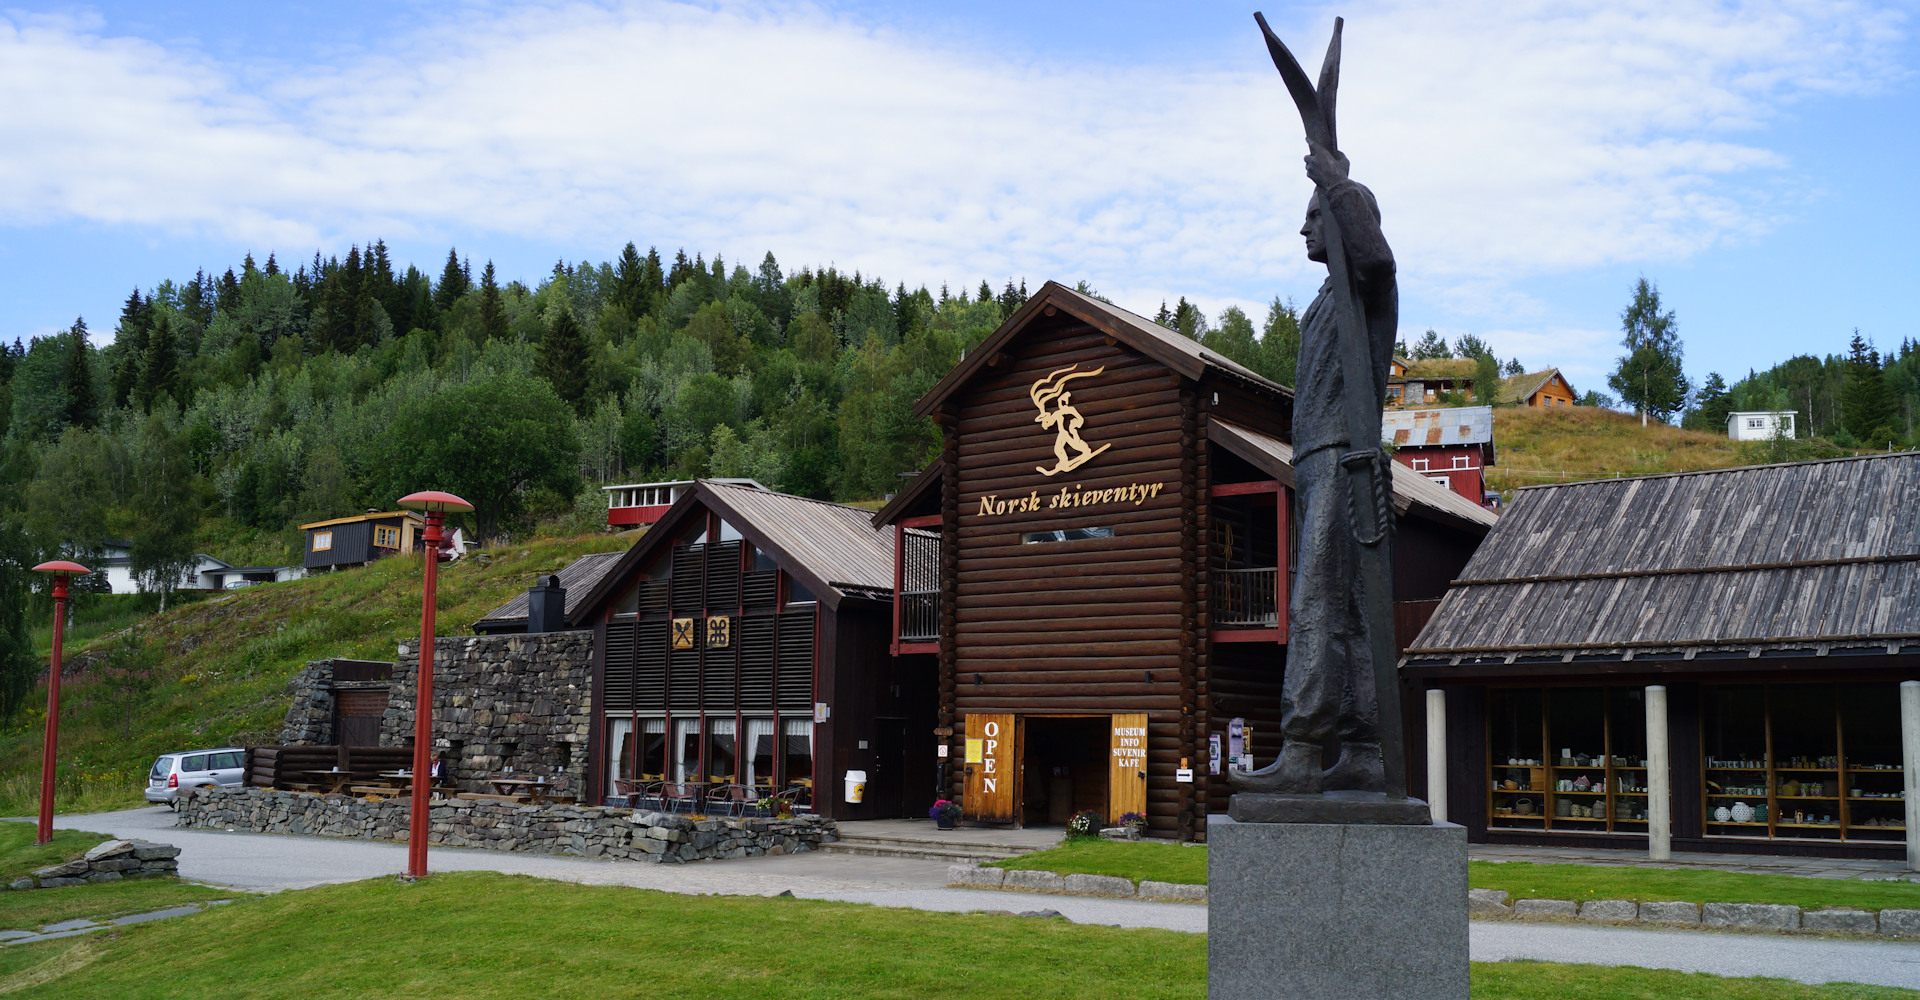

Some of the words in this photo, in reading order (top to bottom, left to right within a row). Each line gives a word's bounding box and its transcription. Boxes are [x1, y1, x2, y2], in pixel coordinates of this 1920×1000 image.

[977, 490, 1040, 516] Norsk
[1049, 482, 1163, 509] skieventyr
[1114, 728, 1146, 736] MUSEUM
[1121, 738, 1139, 746] INFO
[983, 721, 999, 793] OPEN
[1113, 748, 1146, 757] SUVENIR
